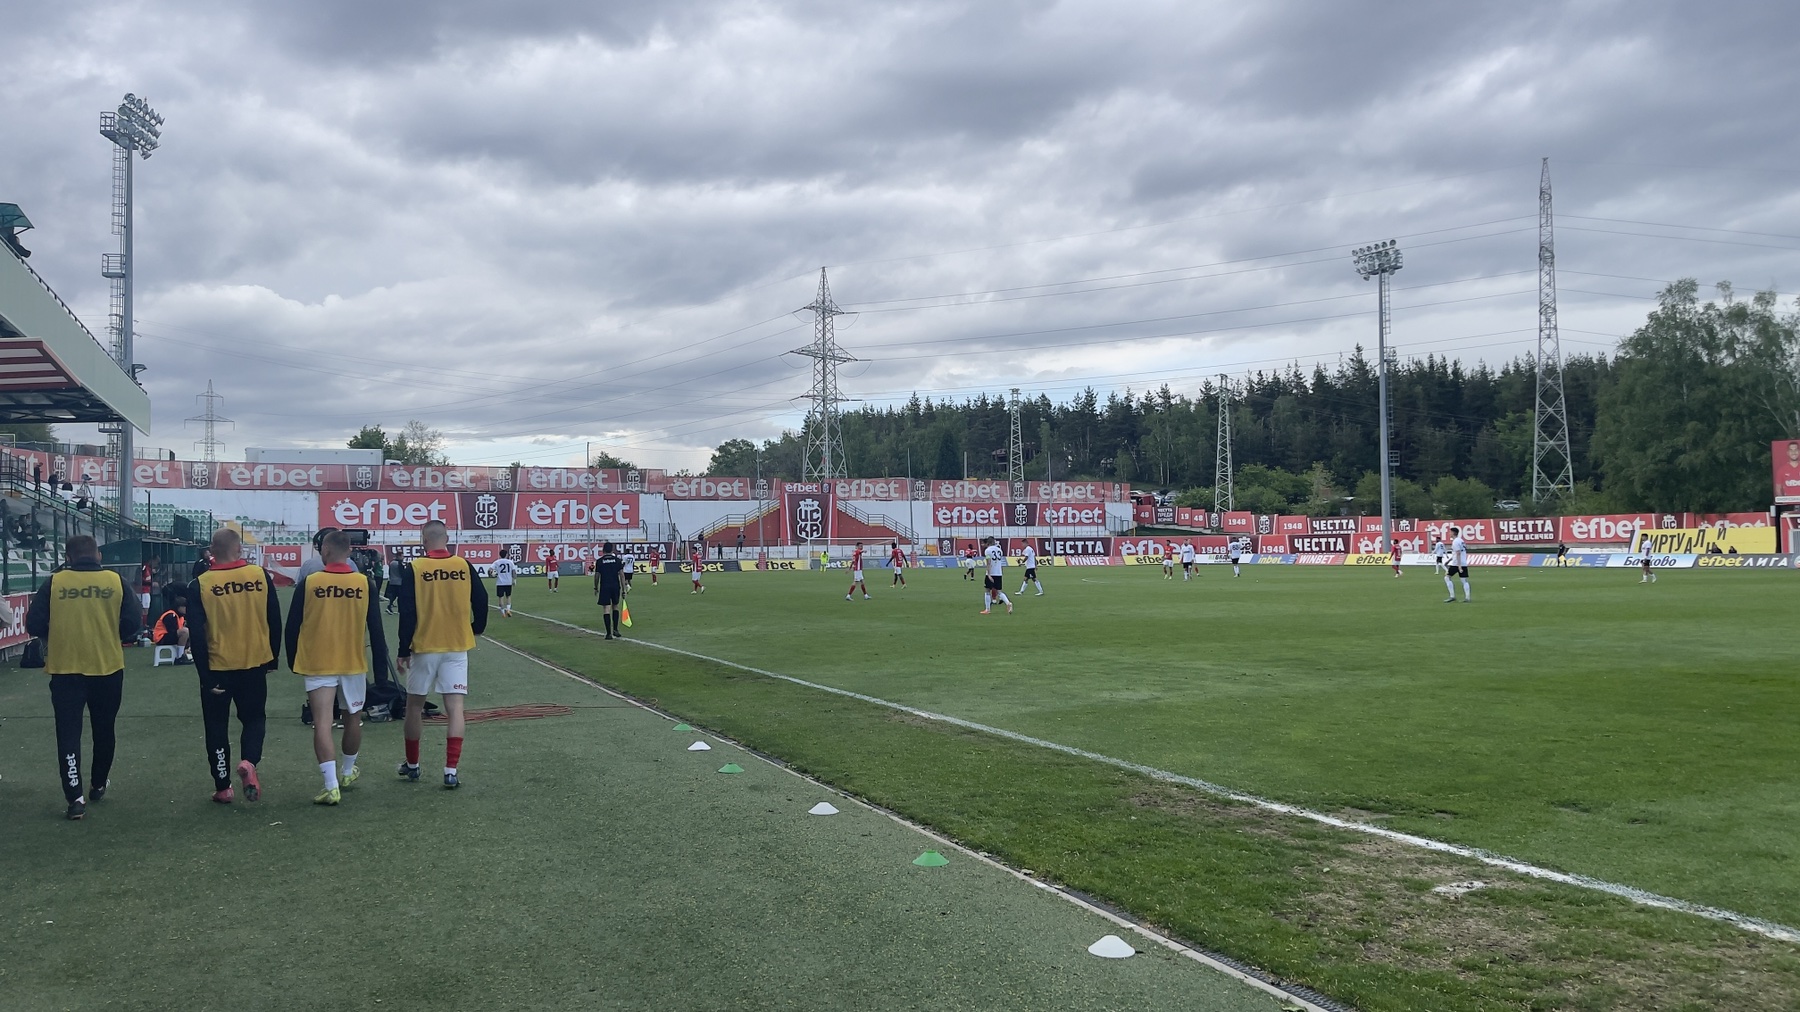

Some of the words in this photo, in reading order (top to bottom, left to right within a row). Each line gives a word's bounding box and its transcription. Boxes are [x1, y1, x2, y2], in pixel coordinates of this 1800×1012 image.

[84, 461, 170, 484] efet
[230, 464, 323, 487] efbet
[392, 467, 477, 488] efbet
[530, 469, 608, 489] efbet
[672, 478, 744, 497] efbet
[785, 484, 818, 492] efbet
[836, 480, 899, 498] efbet
[940, 482, 1000, 499] efbet
[1039, 482, 1095, 499] efbet
[334, 498, 447, 525] efbet
[529, 499, 630, 525] efbet
[937, 506, 999, 524] efbet
[1045, 506, 1103, 524] efbet
[1312, 519, 1356, 531] ЧЕСТТА
[1366, 524, 1383, 532] 194
[1499, 520, 1554, 533] ЧЕСТТА
[1572, 516, 1646, 539] efbet
[537, 544, 603, 561] efbet
[1201, 546, 1227, 554] 1948
[1294, 538, 1345, 551] ЧЕСТТА
[1360, 535, 1424, 554] efet
[464, 550, 492, 558] 1948
[991, 550, 1002, 561] 33
[1067, 556, 1110, 565] WINBET
[1298, 555, 1335, 564] WINBET
[1356, 555, 1388, 564] efbet
[1466, 554, 1516, 565] WINBET
[1624, 556, 1677, 566] Баково
[1699, 556, 1743, 567] efbet
[1743, 557, 1788, 566] ЛИГА
[423, 569, 466, 582] efbet
[499, 563, 510, 573] 21
[213, 580, 263, 596] efbet
[315, 579, 363, 599] efbet
[70, 753, 79, 787] efbet
[219, 748, 228, 779] efbet
